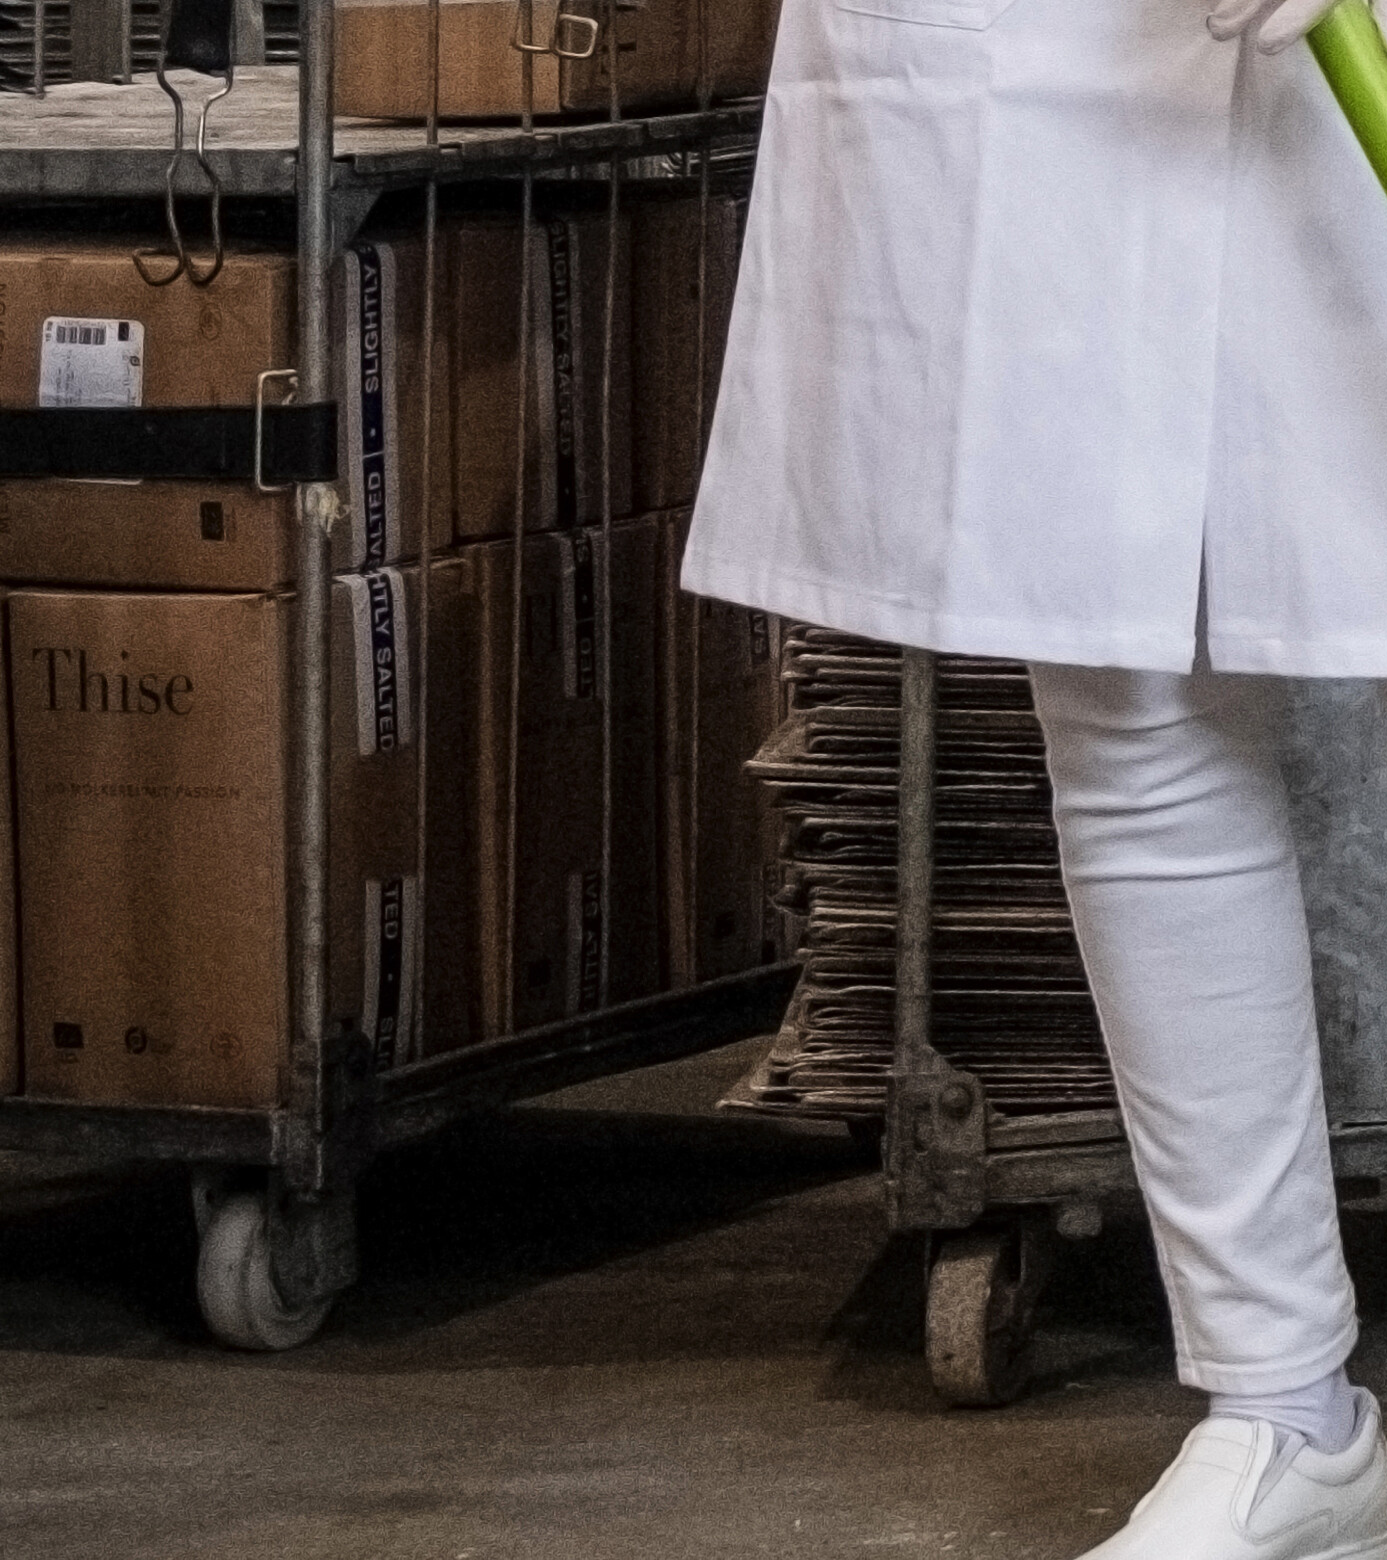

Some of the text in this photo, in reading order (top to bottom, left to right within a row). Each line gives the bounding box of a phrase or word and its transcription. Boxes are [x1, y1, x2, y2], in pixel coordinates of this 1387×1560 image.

[363, 264, 384, 568] SALTED SLIGHTLY
[550, 222, 573, 456] SLIGHTLY SALTED
[32, 648, 194, 716] Thise
[376, 648, 396, 752] SALTED
